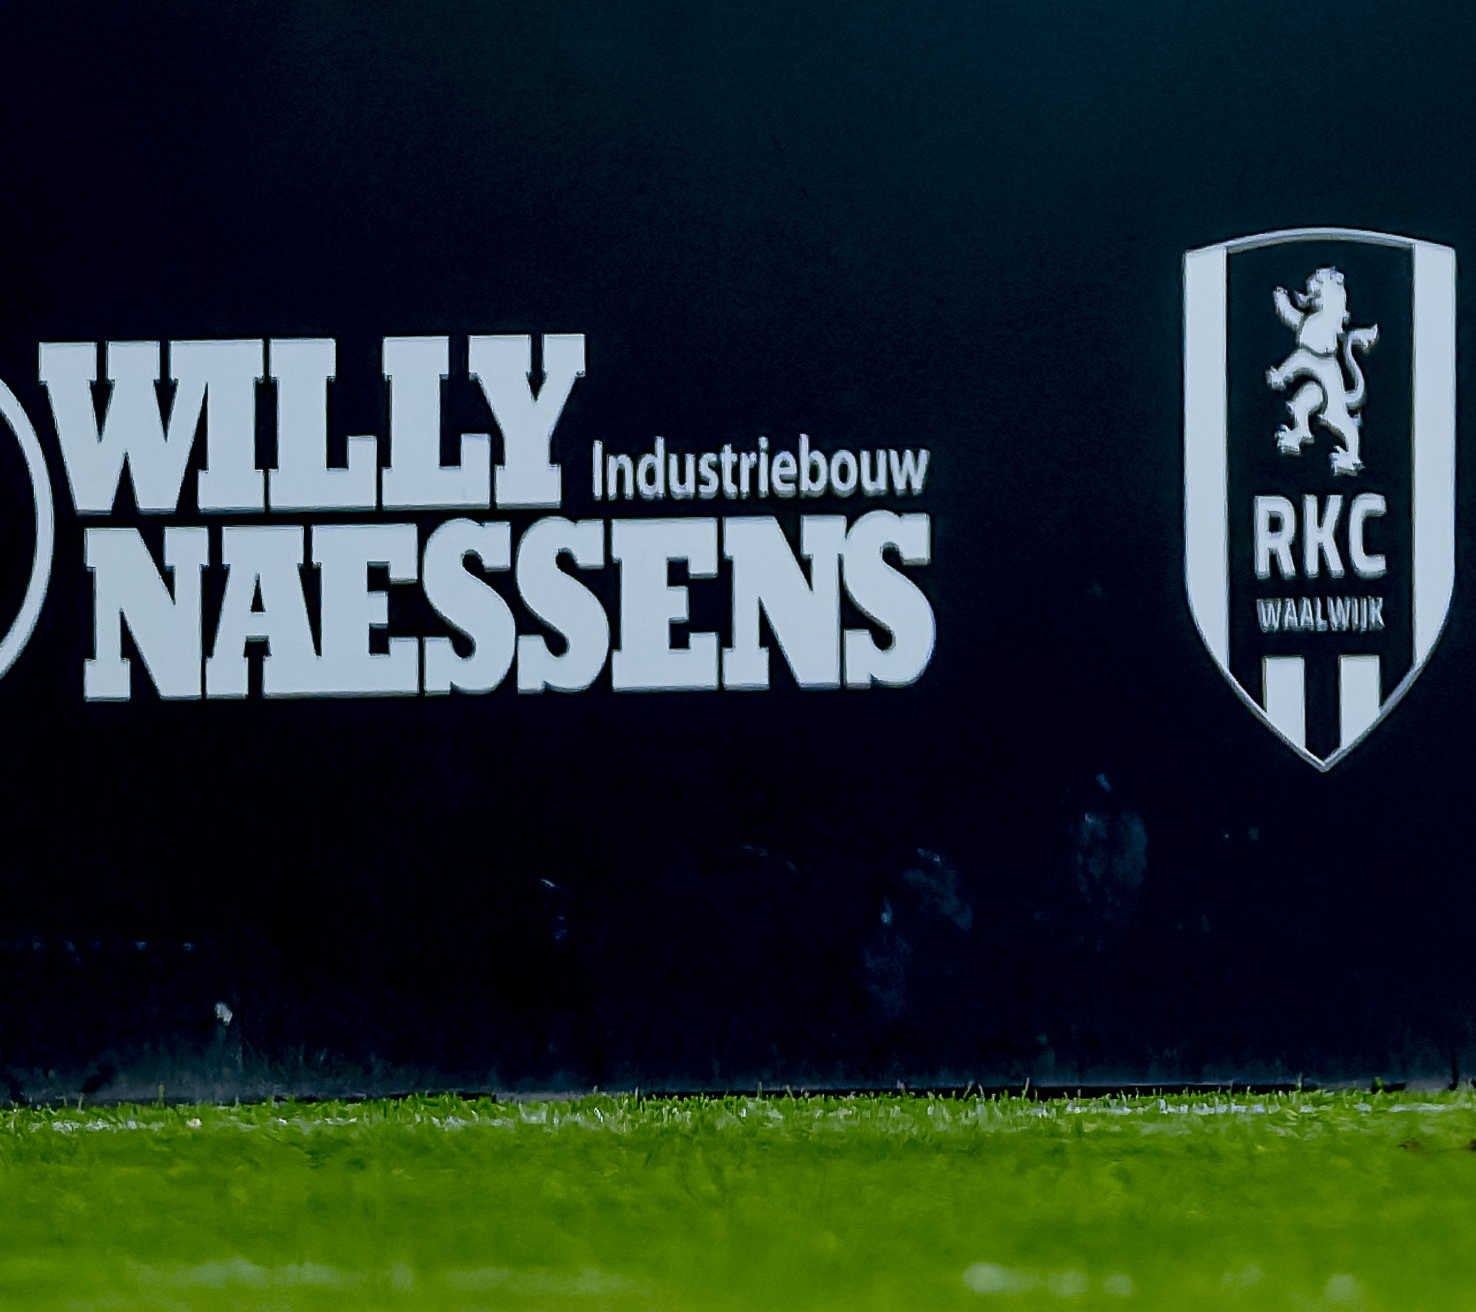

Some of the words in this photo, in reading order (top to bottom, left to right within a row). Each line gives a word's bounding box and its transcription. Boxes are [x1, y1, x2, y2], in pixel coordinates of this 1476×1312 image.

[38, 333, 586, 514] WILLY
[592, 433, 931, 500] Industriebouw
[1253, 492, 1387, 580] RKC
[84, 509, 937, 702] NAESSENS
[1256, 595, 1386, 633] WAALWIJK
